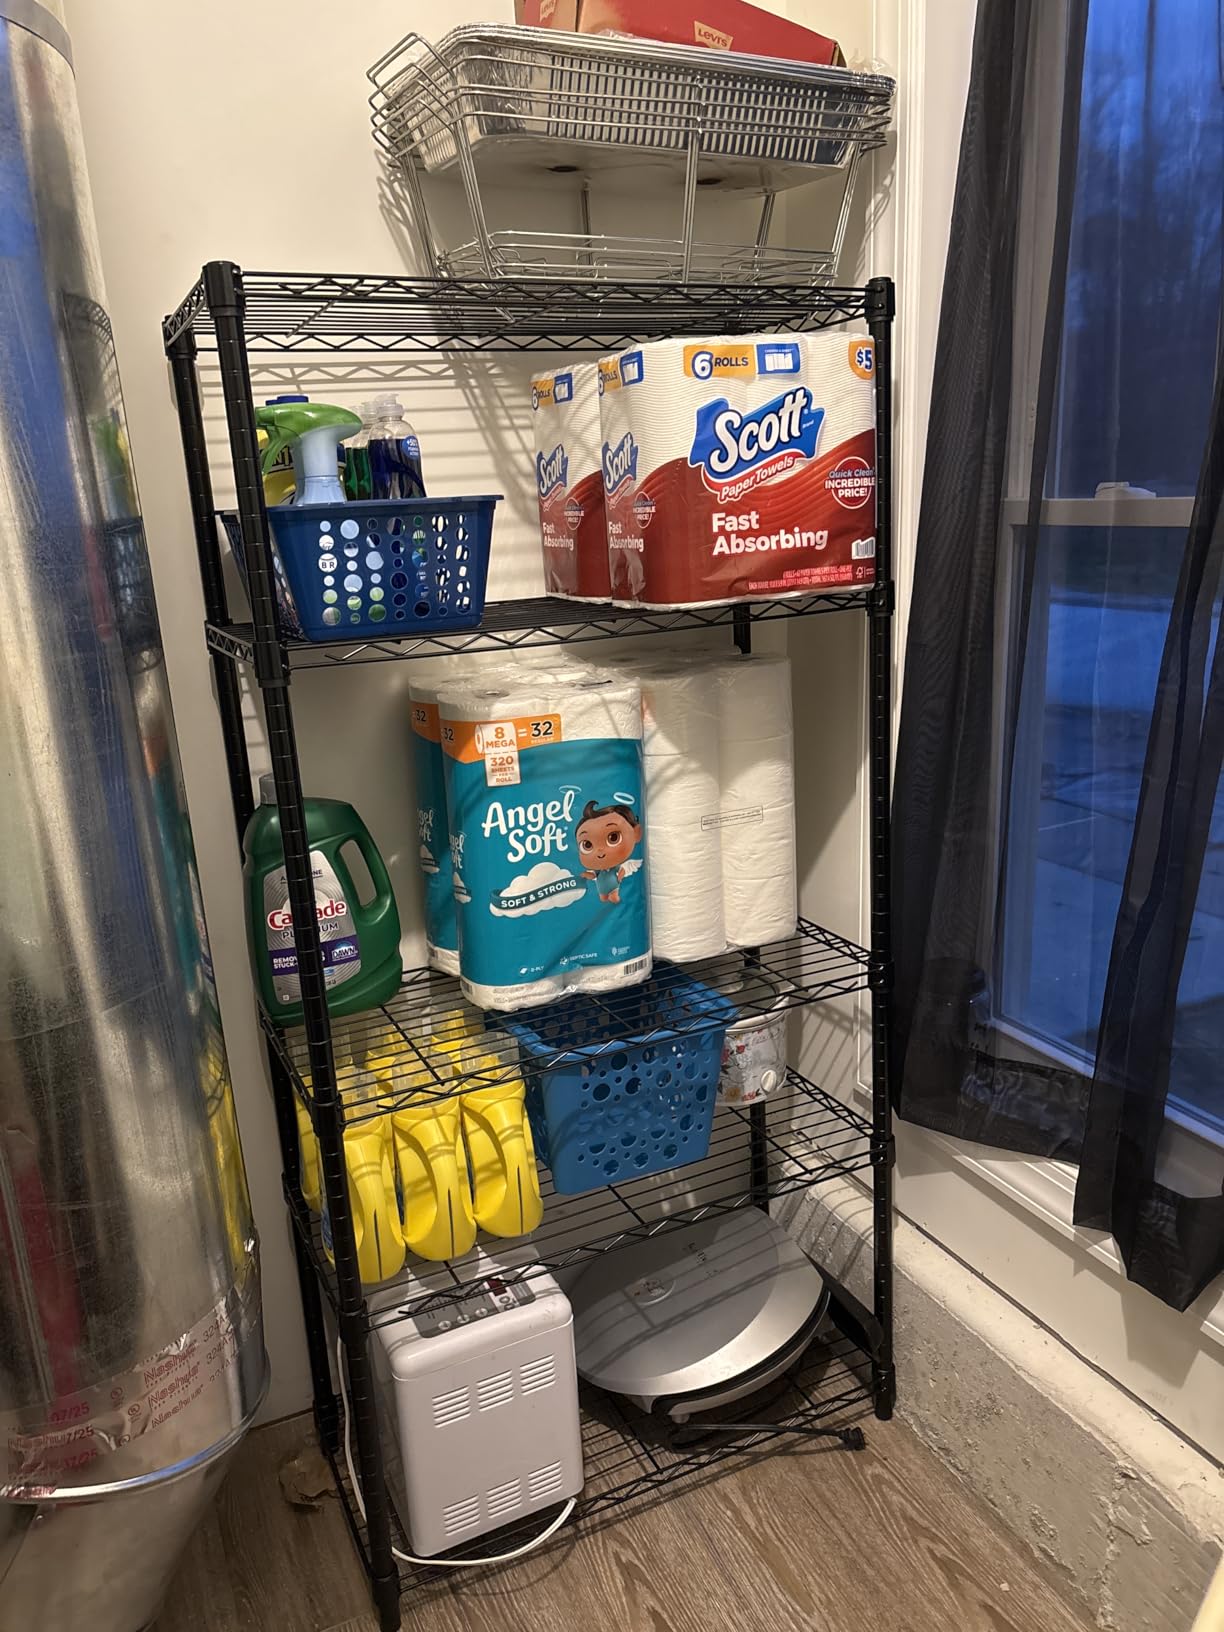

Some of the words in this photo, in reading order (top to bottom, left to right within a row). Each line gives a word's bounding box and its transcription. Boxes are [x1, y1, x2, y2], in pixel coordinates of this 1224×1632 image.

[691, 351, 713, 379] 6
[714, 358, 748, 367] ROLLS
[857, 348, 873, 370] $5
[710, 388, 807, 472] Scott
[606, 434, 632, 489] Scott
[540, 446, 563, 494] Scott
[721, 477, 754, 499] Paper
[755, 456, 794, 482] Towels
[829, 470, 852, 478] Quick
[854, 469, 874, 477] Clean
[825, 477, 875, 489] INCREDIBLE
[838, 488, 867, 498] PRICE!
[543, 522, 554, 534] Fast
[608, 522, 622, 534] Fast
[712, 511, 759, 532] Fast
[544, 536, 574, 551] Absorbing
[610, 535, 644, 552] Absorbing
[712, 527, 828, 555] Absorbing
[416, 710, 426, 722] 32
[443, 728, 454, 741] 32
[494, 727, 505, 739] 8
[531, 721, 553, 737] 32
[486, 739, 516, 748] MEGA
[490, 756, 514, 766] 320
[481, 790, 575, 838] Angel
[507, 822, 568, 862] Soft
[501, 898, 527, 908] SOFT
[538, 880, 577, 897] STRONG
[269, 900, 345, 929] Caade
[332, 946, 355, 960] DAWN
